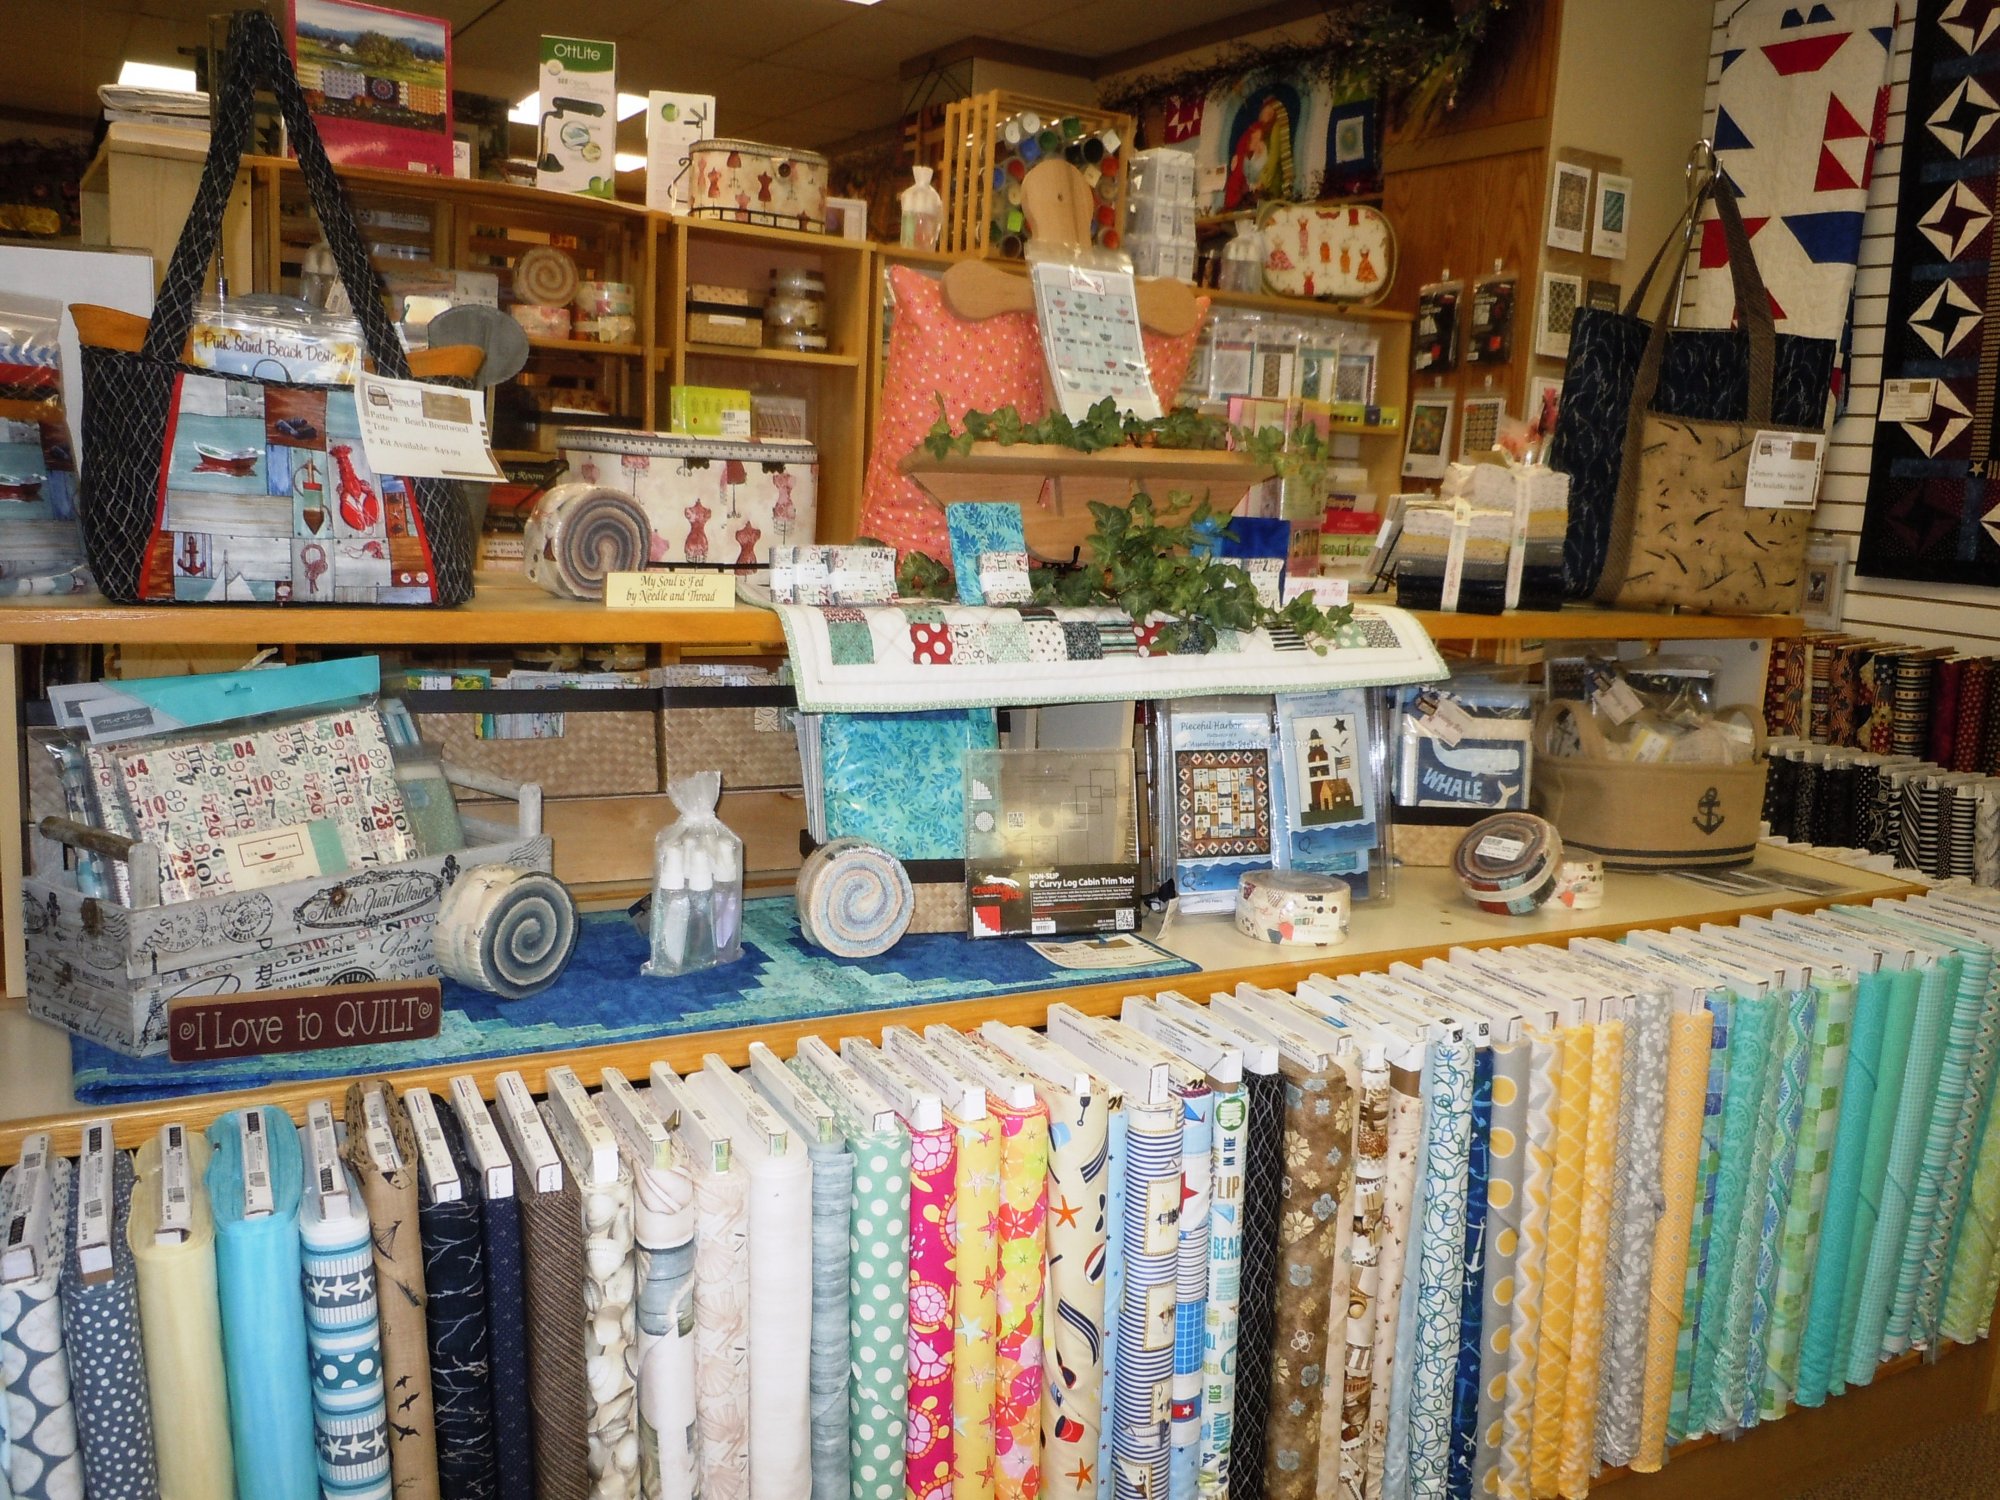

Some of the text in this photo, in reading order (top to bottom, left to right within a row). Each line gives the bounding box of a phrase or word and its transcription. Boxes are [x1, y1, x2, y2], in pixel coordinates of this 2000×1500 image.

[554, 43, 600, 60] OttLite
[202, 331, 231, 350] Pink
[234, 335, 263, 355] Sand
[266, 339, 303, 359] Beach
[405, 417, 427, 428] Beach
[429, 421, 469, 433] Brentwood
[380, 438, 391, 446] Kit
[517, 470, 544, 480] Room
[640, 575, 706, 588] My Soul is Fed
[626, 588, 717, 606] by Needle and Thread
[97, 712, 147, 726] moda
[1180, 720, 1242, 732] Pieceful Harbor
[1422, 767, 1483, 801] WHALE
[1028, 872, 1060, 880] NON-SLIP
[1039, 880, 1061, 889] Curvy
[1063, 879, 1078, 889] Log
[1078, 877, 1100, 886] Cabin
[1101, 877, 1119, 885] Trim
[1119, 876, 1135, 885] Tool
[363, 887, 392, 917] Quai
[384, 877, 432, 908] Voltaire
[196, 997, 420, 1051] I Love to QUILT
[1223, 1136, 1236, 1166] IN THE
[1217, 1175, 1240, 1199] LIP
[1213, 1235, 1241, 1260] BEAC
[1208, 1385, 1222, 1404] TOES
